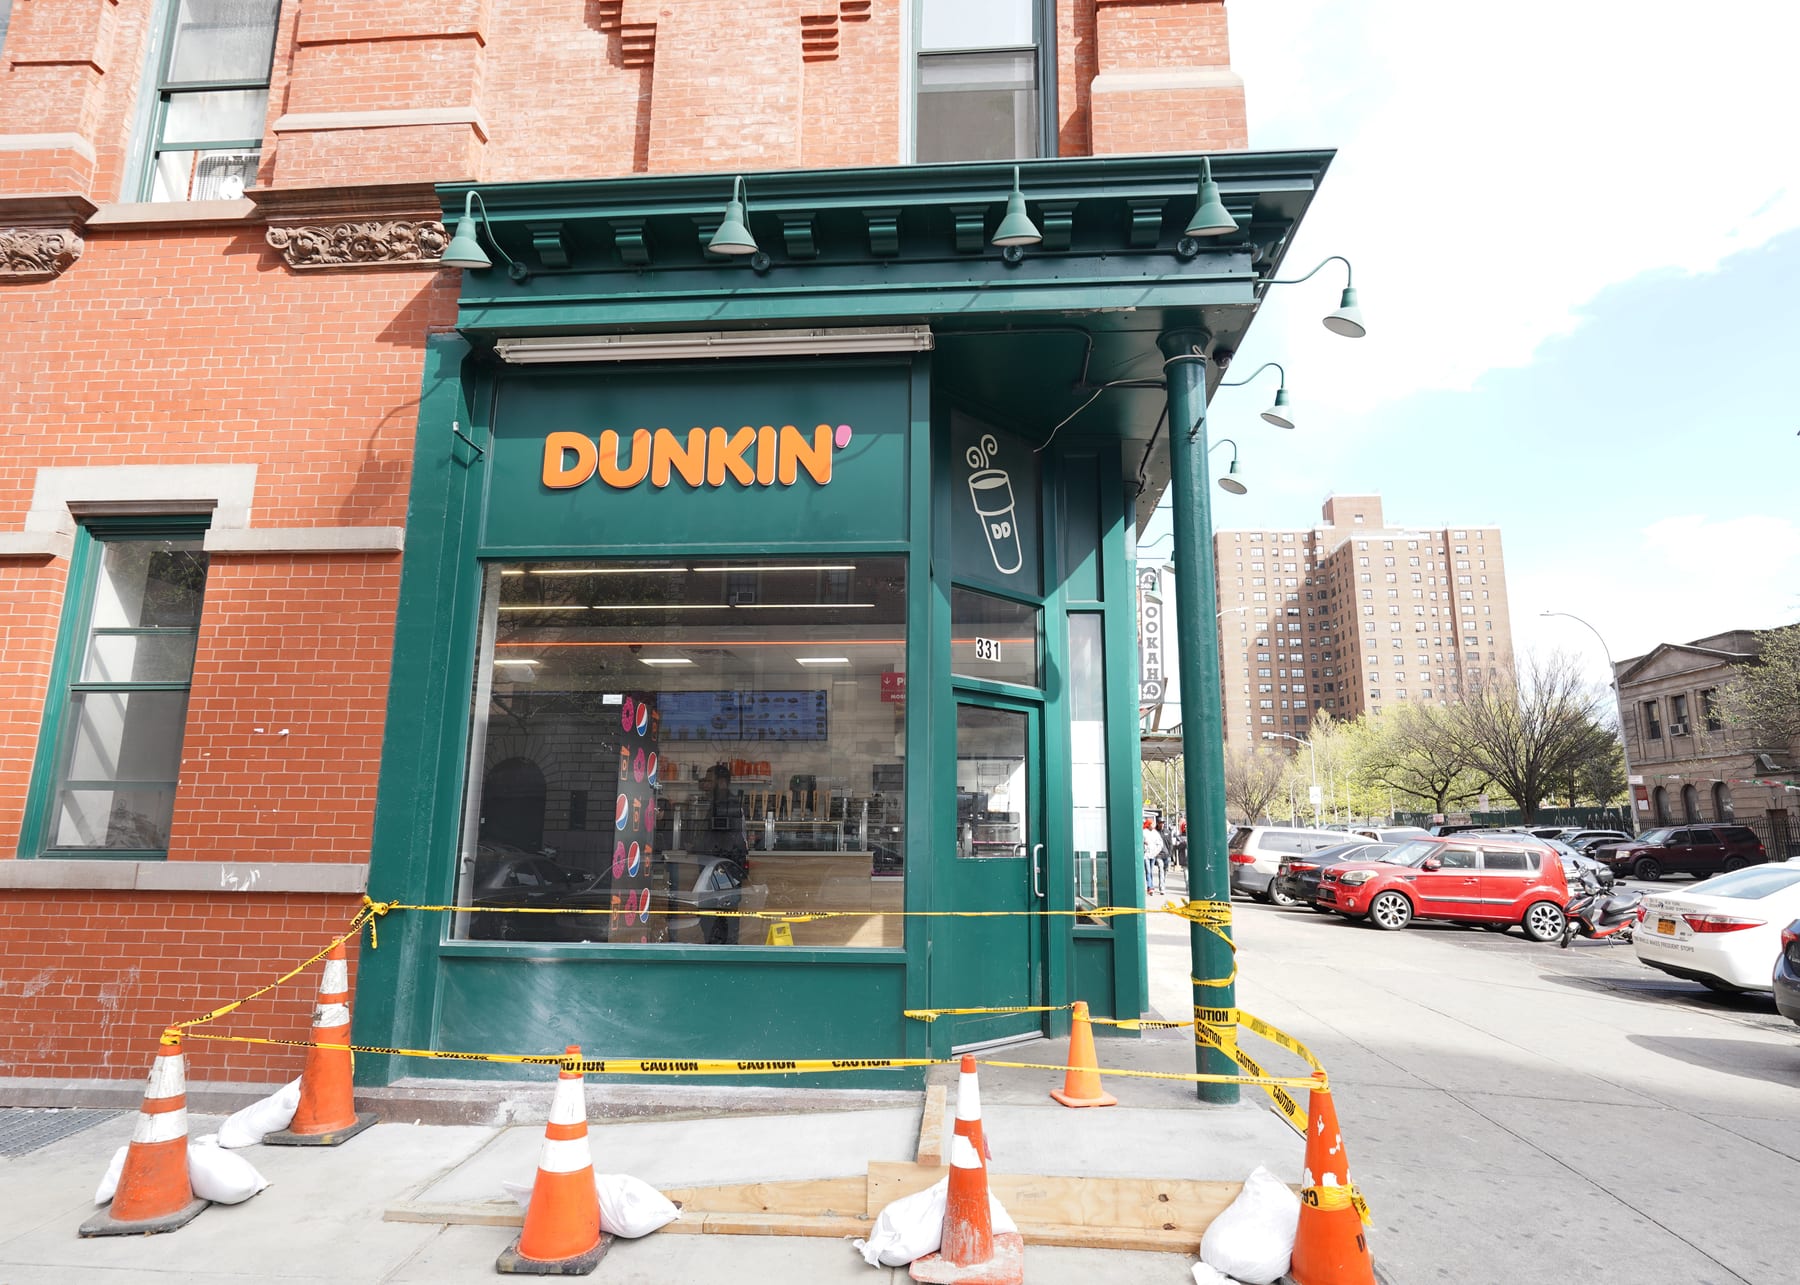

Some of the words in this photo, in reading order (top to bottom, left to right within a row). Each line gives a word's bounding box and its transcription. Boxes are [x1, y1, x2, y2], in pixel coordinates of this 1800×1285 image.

[542, 424, 852, 489] DUNKIN'
[990, 522, 1011, 539] DD
[1145, 593, 1159, 680] OOKAH
[977, 638, 999, 660] 331
[1680, 944, 1695, 953] STOPS
[1194, 1007, 1229, 1022] AUTION
[1197, 1021, 1222, 1048] CAUTION
[640, 1061, 699, 1072] CAUTION
[737, 1061, 797, 1071] CAUTION
[1236, 1050, 1259, 1077] CAUTION
[1272, 1085, 1296, 1116] CAUTION
